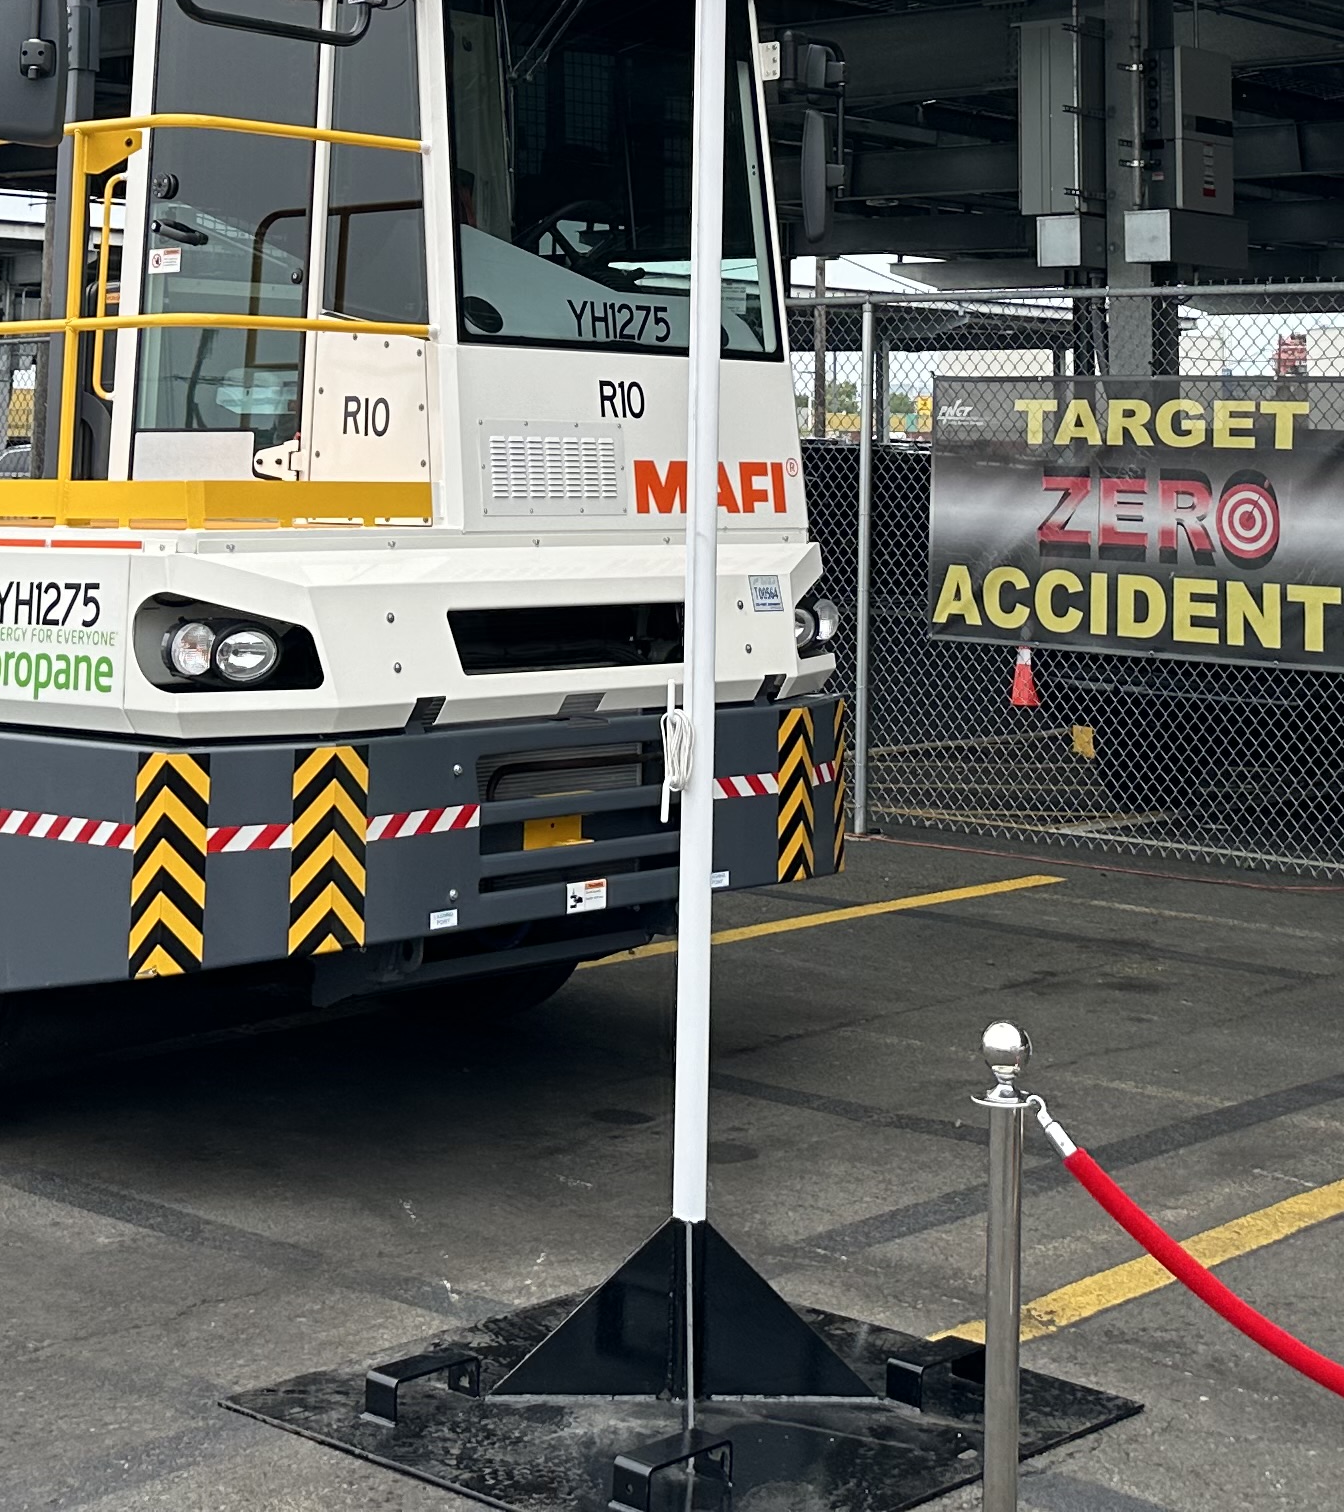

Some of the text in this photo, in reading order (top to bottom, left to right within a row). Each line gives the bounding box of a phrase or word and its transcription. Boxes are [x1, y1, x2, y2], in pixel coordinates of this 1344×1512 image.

[567, 299, 671, 343] YH1275
[342, 395, 390, 437] R10
[599, 379, 645, 419] R10
[1013, 398, 1309, 450] TARGET
[1036, 473, 1280, 564] ZERO
[31, 628, 53, 643] FOR
